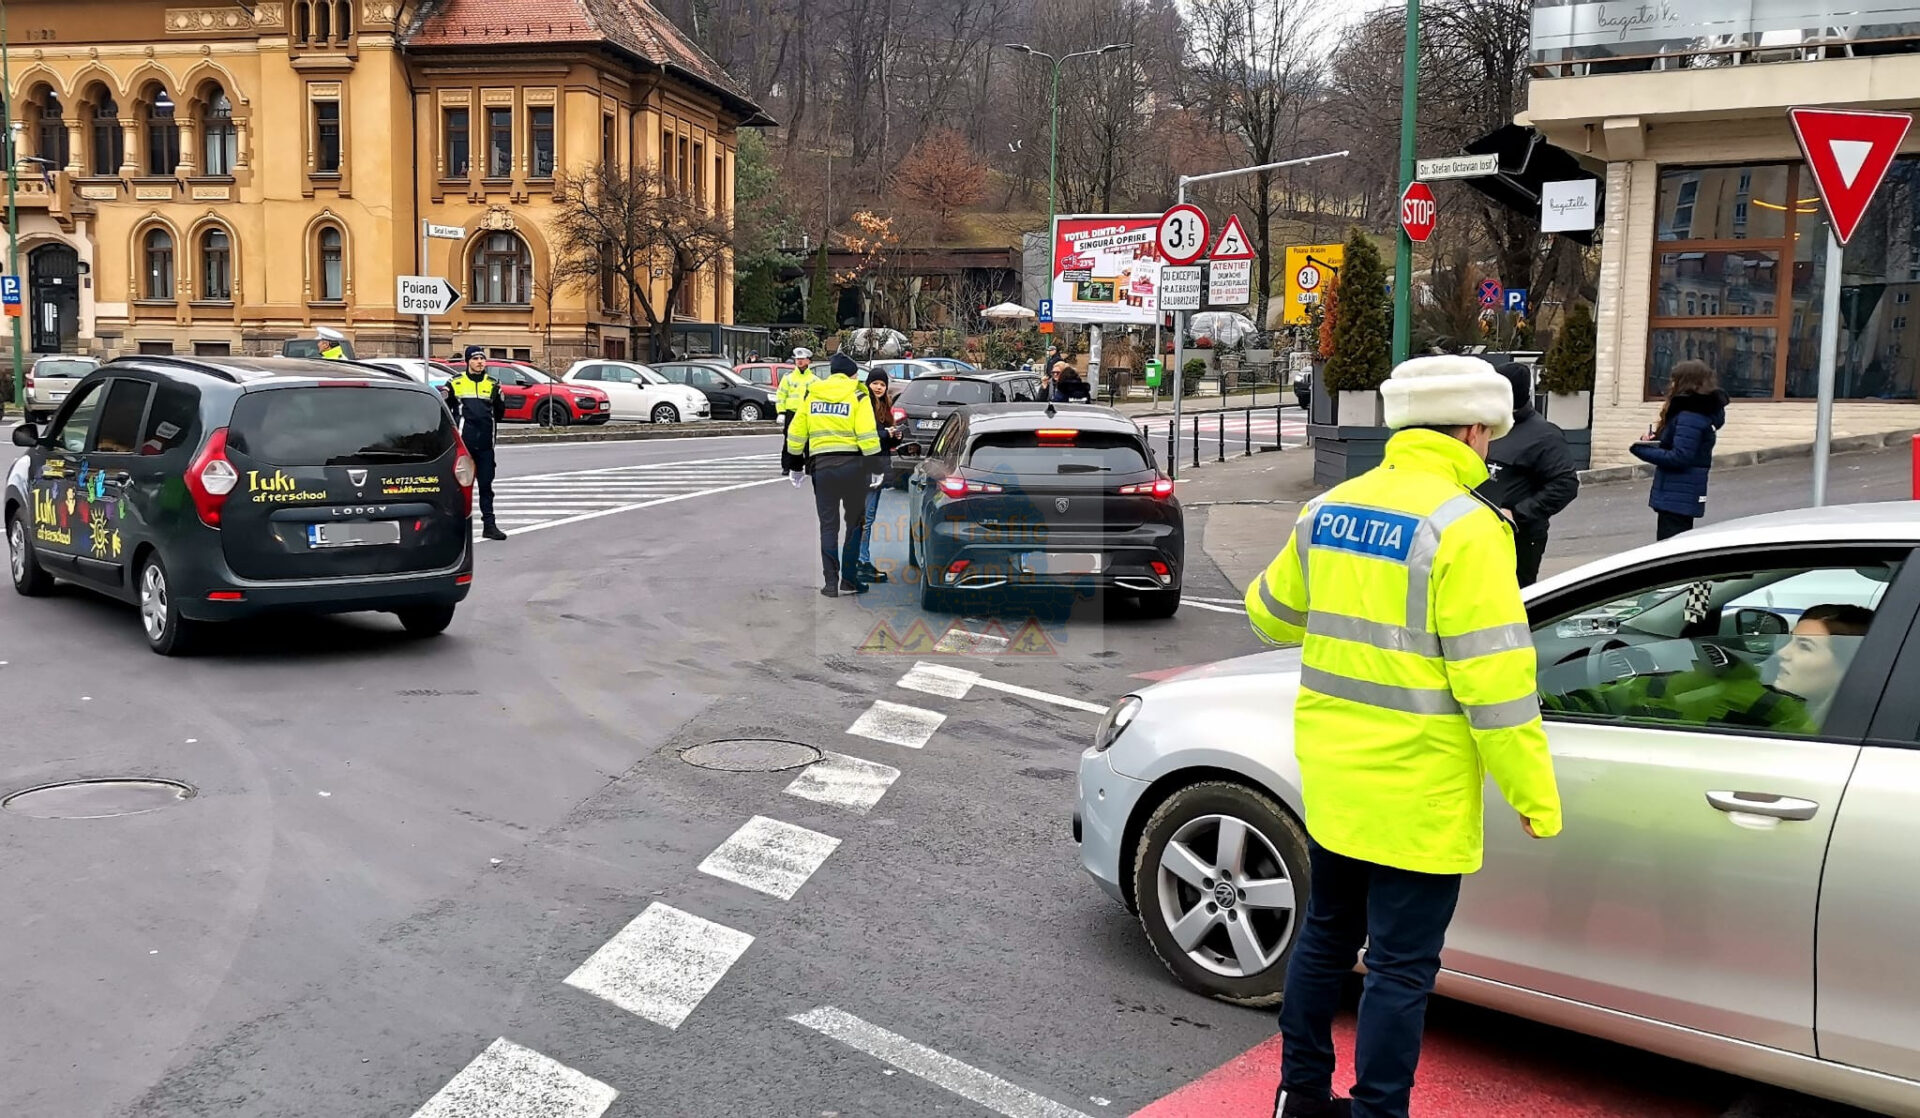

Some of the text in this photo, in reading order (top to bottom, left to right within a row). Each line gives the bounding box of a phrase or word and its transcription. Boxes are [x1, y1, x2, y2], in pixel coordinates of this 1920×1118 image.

[1453, 161, 1478, 173] Octavian
[1549, 196, 1588, 214] bagatelle
[1403, 199, 1435, 225] STOP
[1065, 225, 1125, 241] TOTUL DINTR-O
[1116, 233, 1147, 244] OPRIRE
[1162, 271, 1171, 281] CU
[402, 280, 438, 294] Poiana
[252, 490, 327, 502] afterschool
[332, 505, 387, 516] LODGY
[1316, 513, 1403, 550] POLITIA
